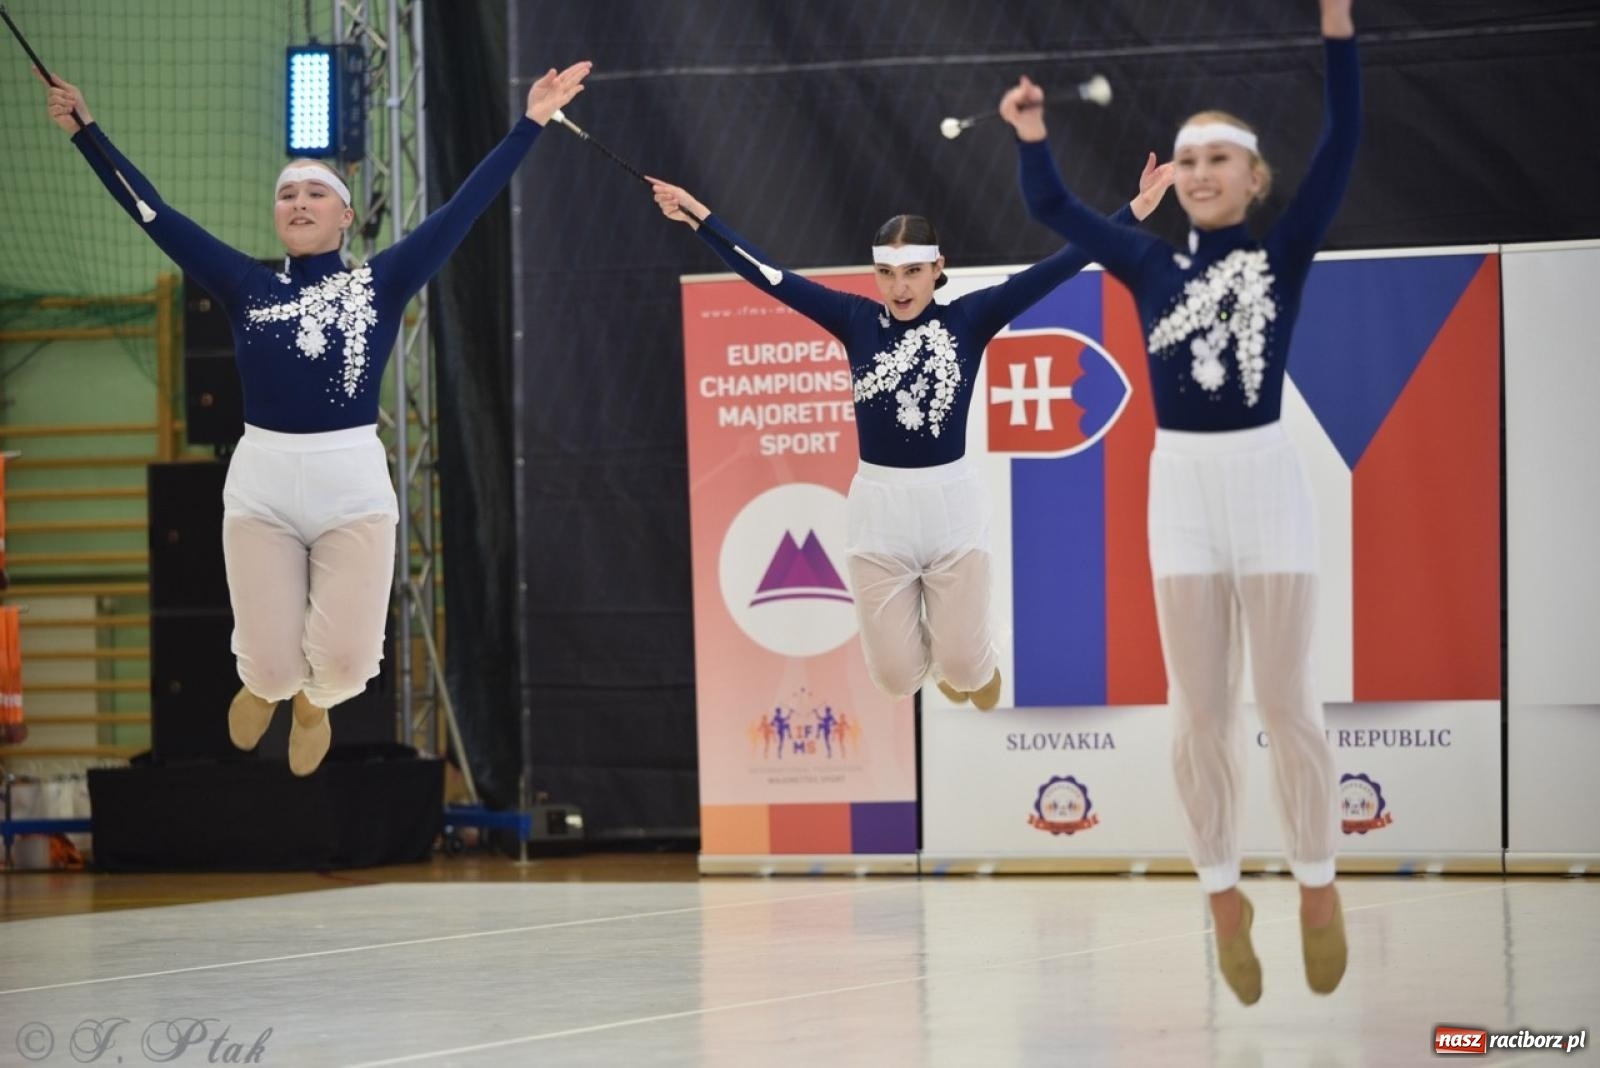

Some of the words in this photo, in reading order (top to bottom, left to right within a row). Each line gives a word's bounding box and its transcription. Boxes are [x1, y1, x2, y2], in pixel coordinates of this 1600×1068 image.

[700, 371, 852, 398] CHAMPIONS
[760, 432, 840, 456] SPORT
[1006, 732, 1116, 751] SLOVAKIA
[1338, 729, 1452, 748] REPUBLIC
